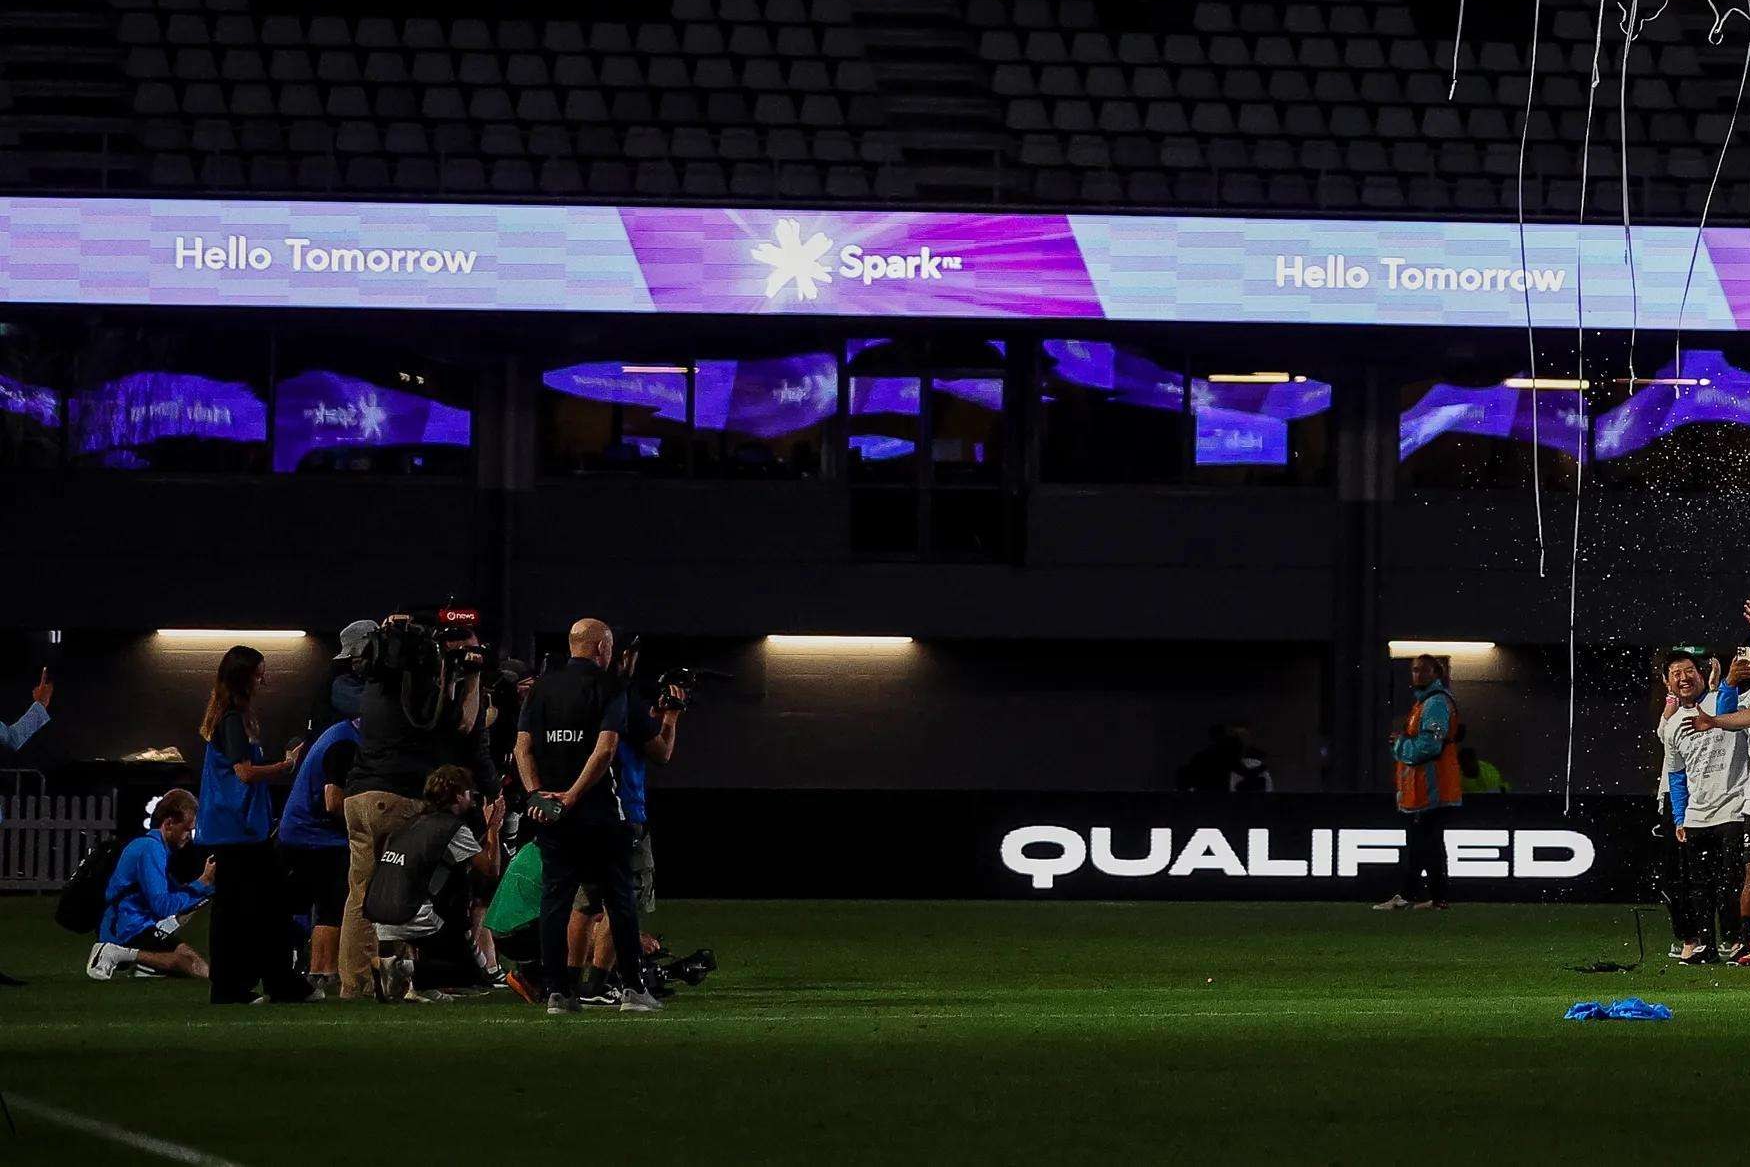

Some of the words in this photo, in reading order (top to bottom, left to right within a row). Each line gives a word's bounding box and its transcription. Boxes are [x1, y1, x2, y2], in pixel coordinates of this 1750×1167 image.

[175, 235, 272, 270] Hello
[285, 238, 477, 274] Tomorrow
[839, 245, 943, 285] Spark
[1275, 254, 1370, 290] Hello
[1380, 257, 1566, 292] Tomorrow
[546, 729, 584, 743] MEDIA
[380, 850, 406, 866] EDIA
[1001, 826, 1595, 889] QUALIFED
